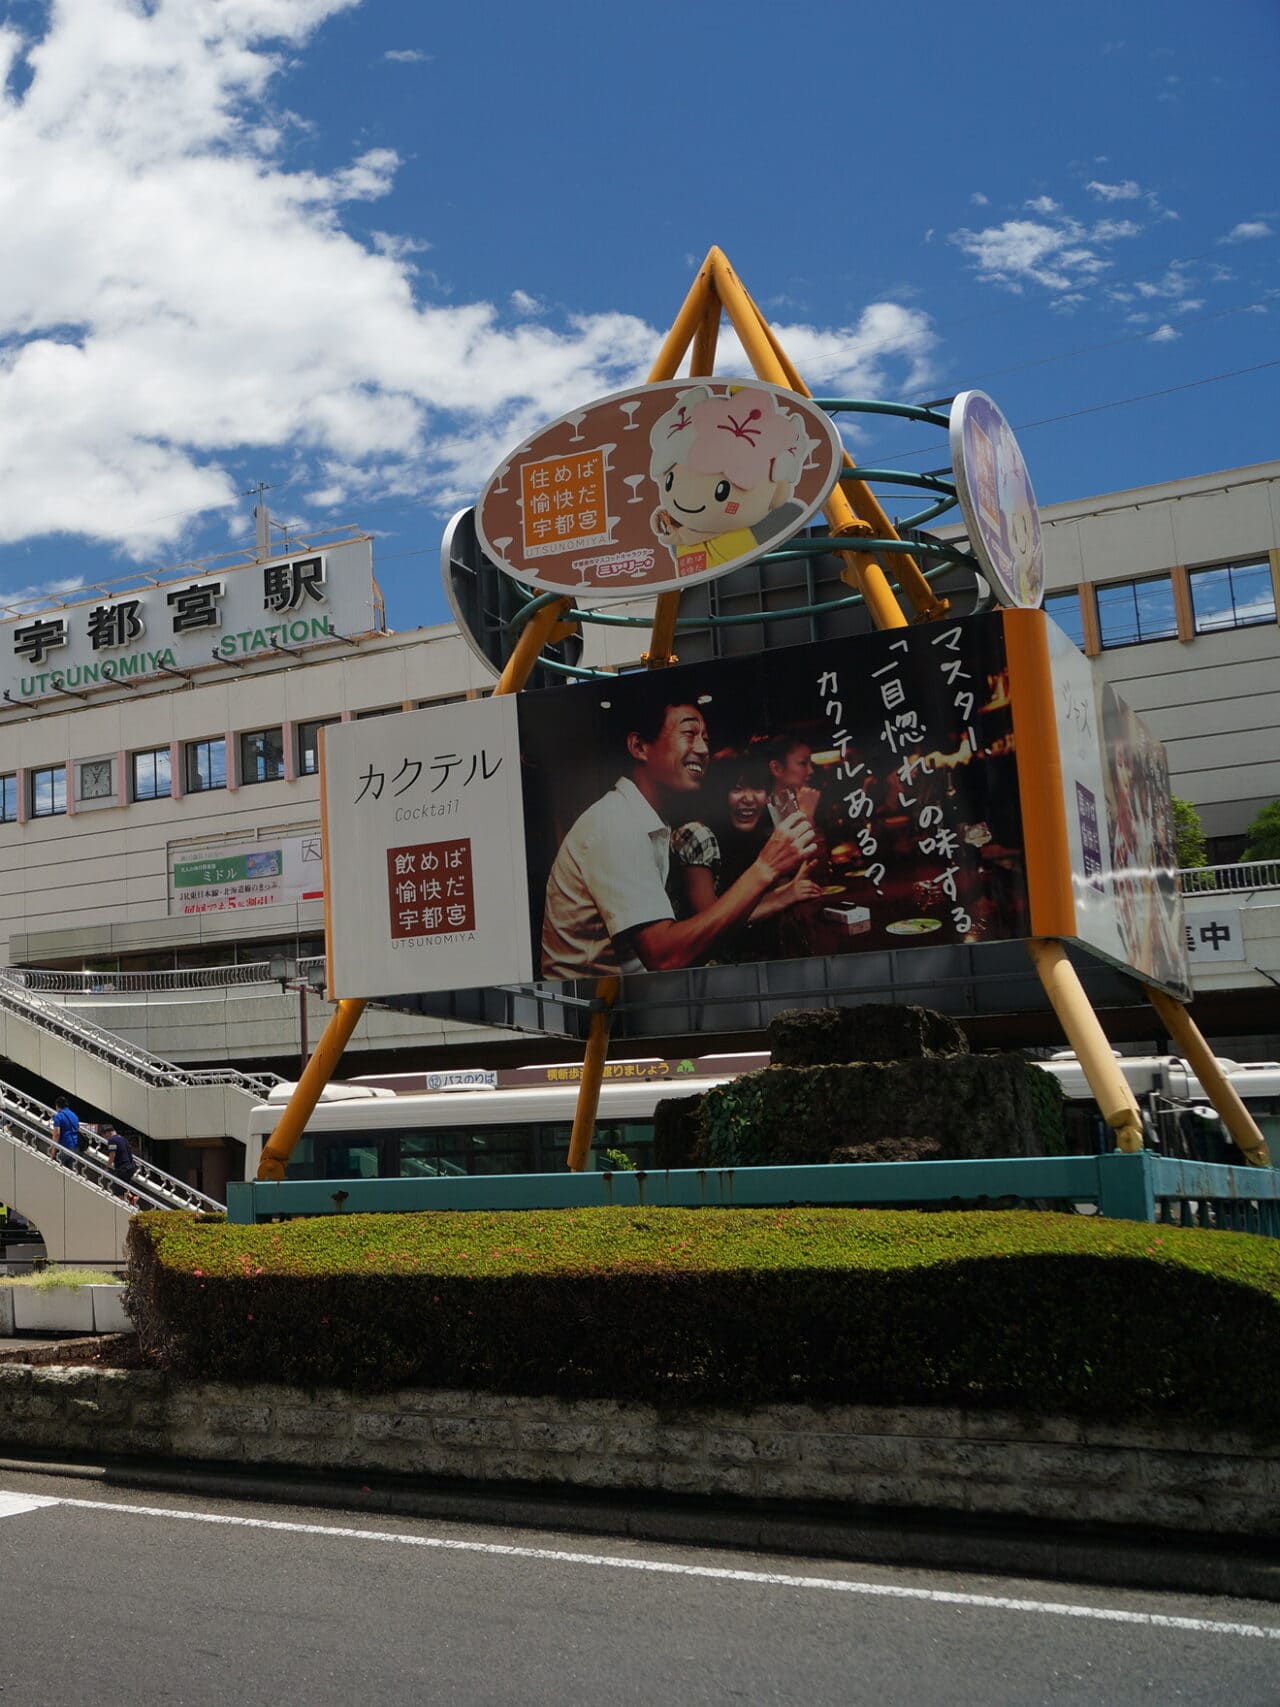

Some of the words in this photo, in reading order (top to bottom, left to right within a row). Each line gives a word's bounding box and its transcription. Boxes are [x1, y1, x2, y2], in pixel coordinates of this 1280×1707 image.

[530, 458, 598, 489] 住めば
[530, 484, 597, 514] 愉快だ
[533, 509, 598, 538] 宇都宮
[525, 535, 606, 557] UTSUNOMIYA
[14, 556, 327, 664] 宇都宮駅
[20, 647, 176, 697] UTSUNOMIYA
[221, 615, 330, 656] STATION
[353, 749, 503, 804] カクテル
[394, 799, 460, 823] Cocktail
[203, 867, 238, 882] ミドル
[394, 846, 466, 876] 飲めば
[395, 876, 465, 904] 愉快だ
[397, 904, 467, 930] 宇都宮
[391, 932, 476, 950] UTSUNOMIYA
